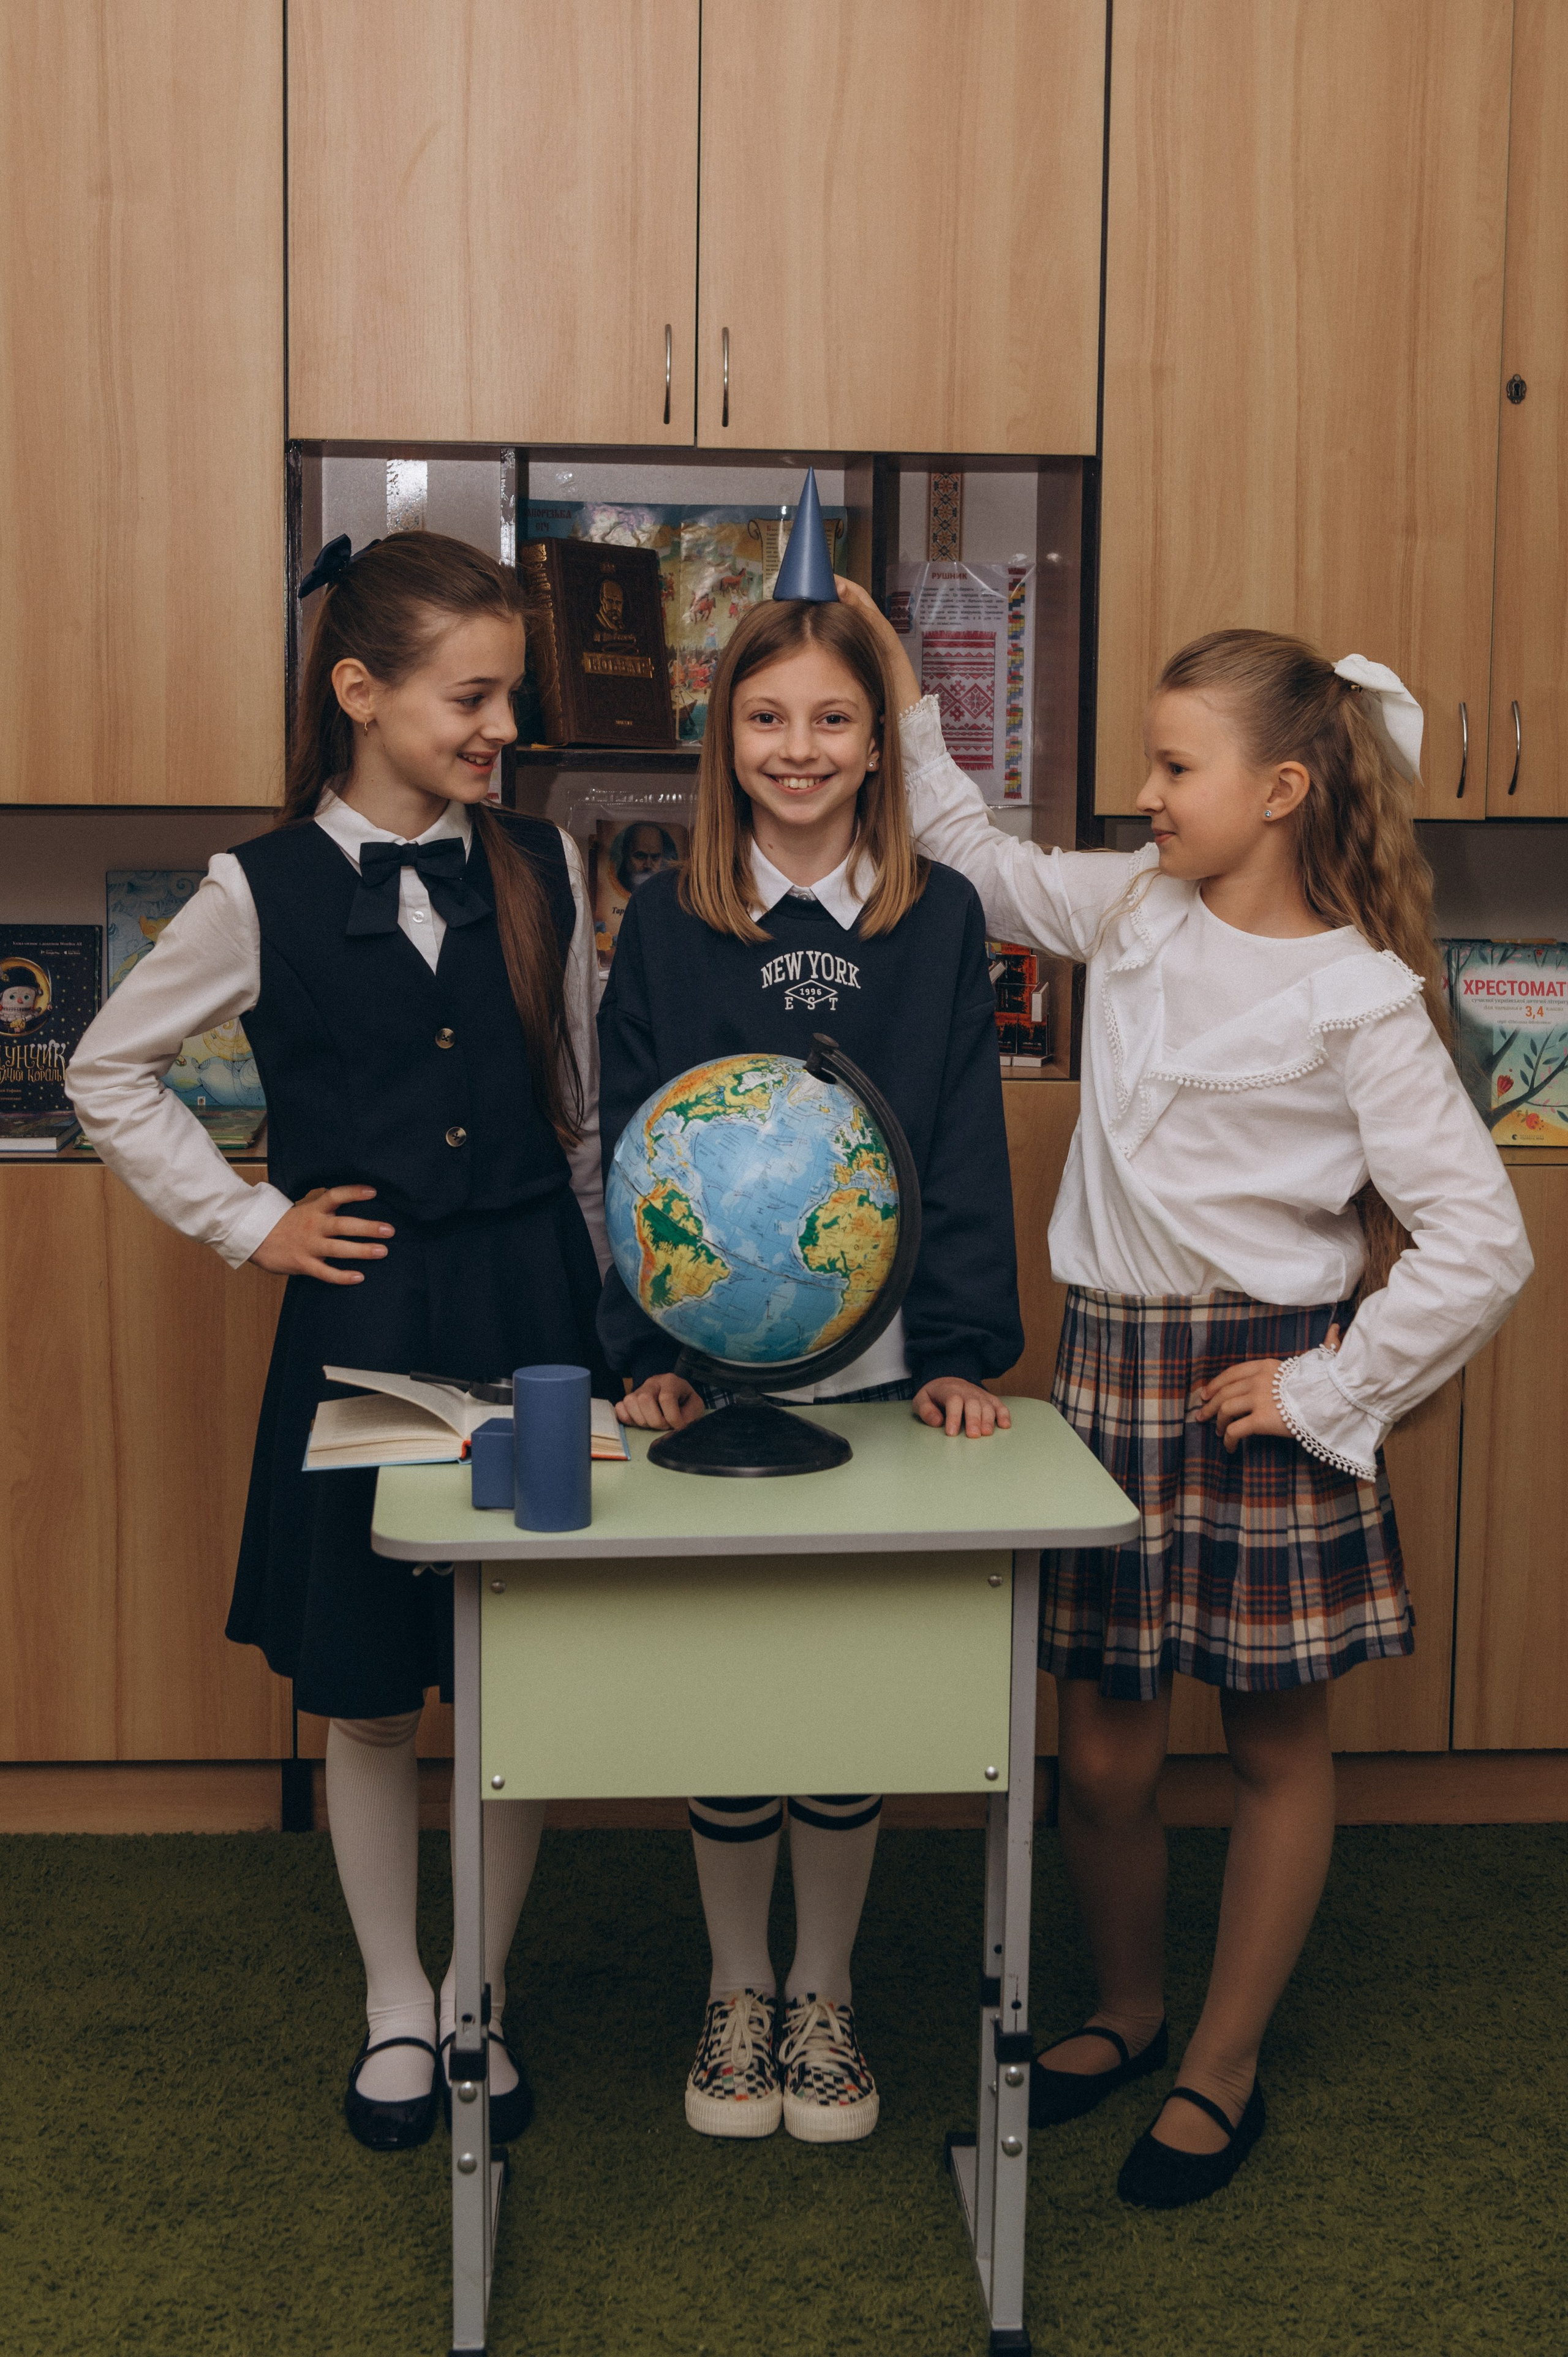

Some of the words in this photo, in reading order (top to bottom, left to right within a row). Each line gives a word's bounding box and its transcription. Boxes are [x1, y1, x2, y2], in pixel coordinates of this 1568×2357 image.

[761, 951, 804, 989] NEW
[805, 950, 861, 989] YORK
[1463, 980, 1568, 997] ХРЕСТОМАТ
[0, 1039, 66, 1082] УНЧИК
